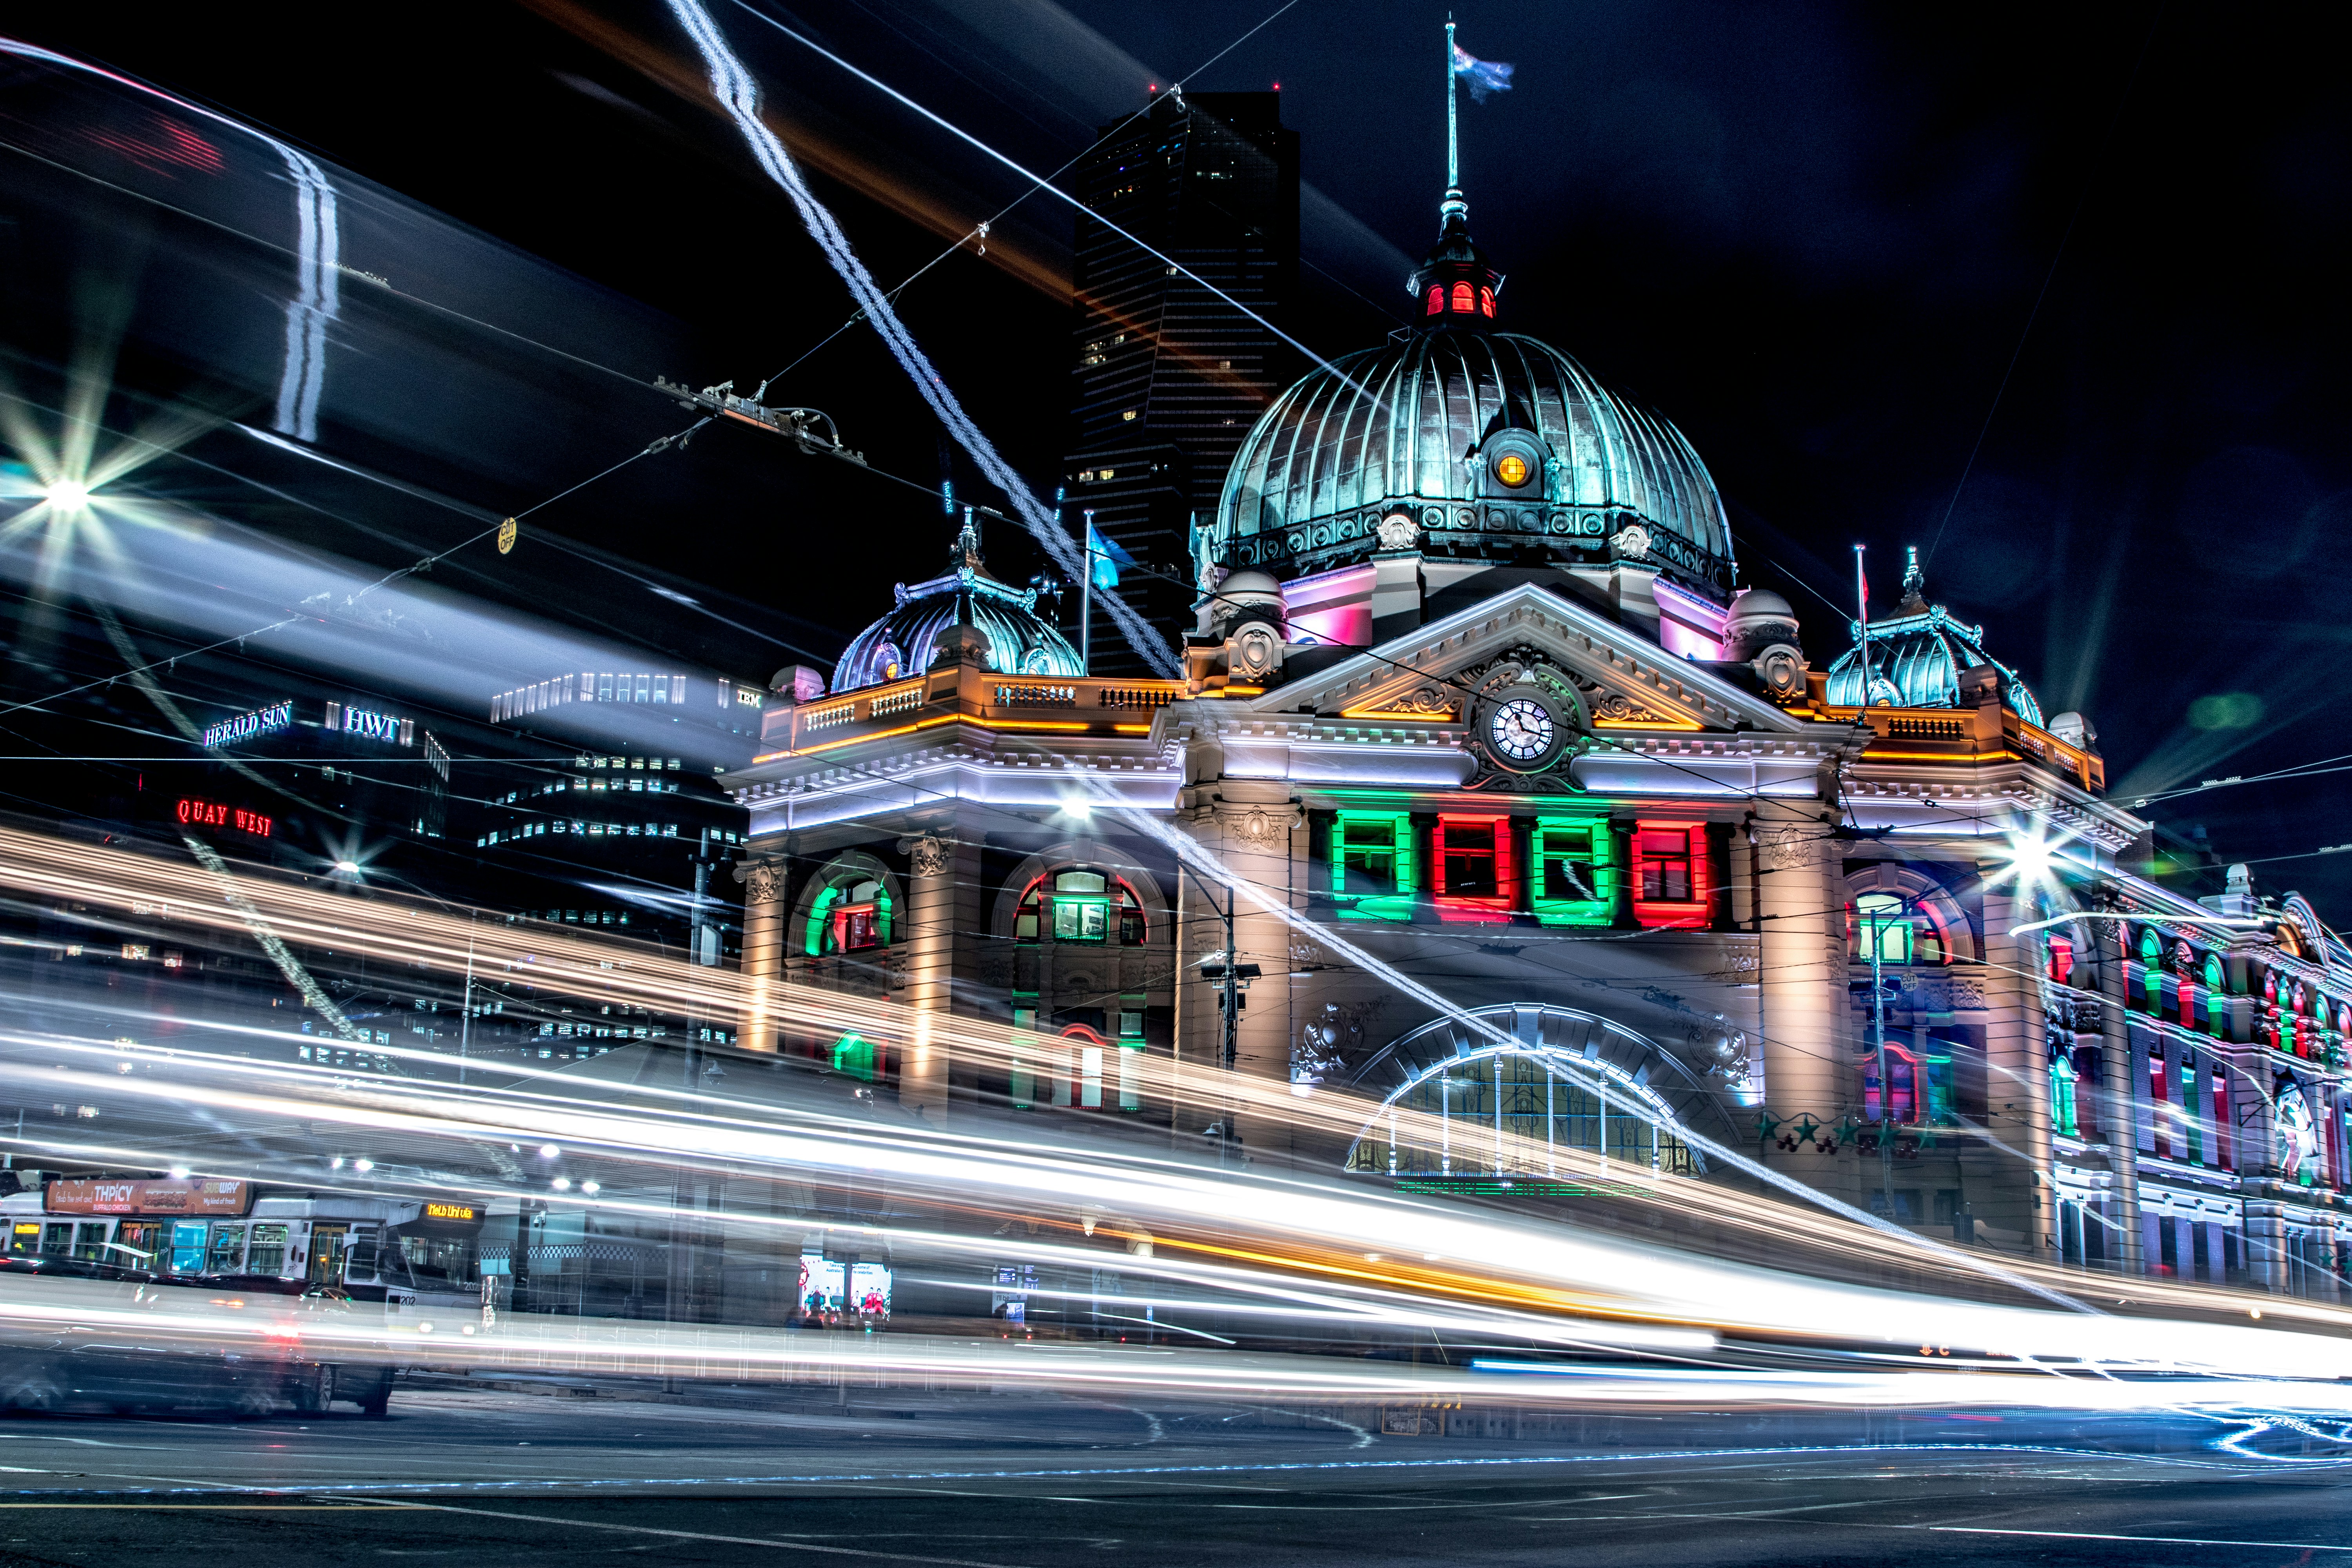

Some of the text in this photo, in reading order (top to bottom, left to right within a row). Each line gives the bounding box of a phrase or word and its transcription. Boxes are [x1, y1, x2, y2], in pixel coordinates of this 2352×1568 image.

[501, 521, 514, 536] CUT
[501, 535, 514, 550] OFF
[205, 705, 291, 746] HERALD SUN
[345, 707, 399, 739] HWT
[178, 800, 271, 836] QUAY WEST
[203, 1181, 240, 1194] SUBWAY
[203, 1198, 210, 1206] My
[460, 1207, 472, 1218] via
[401, 1296, 416, 1306] 202
